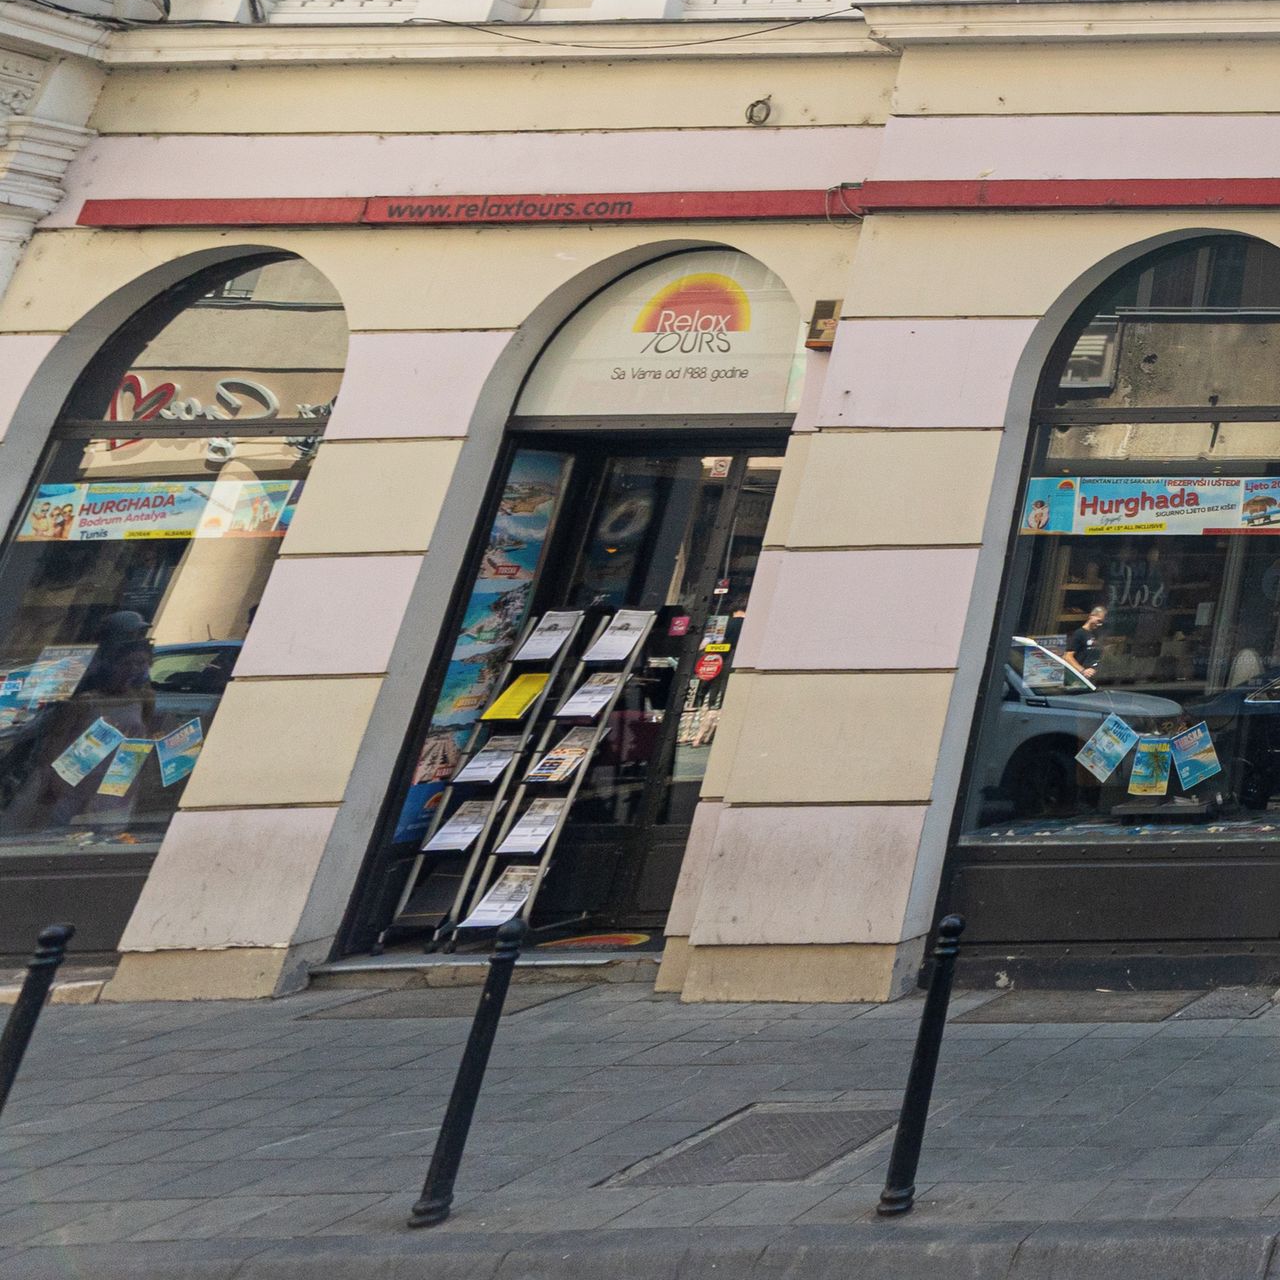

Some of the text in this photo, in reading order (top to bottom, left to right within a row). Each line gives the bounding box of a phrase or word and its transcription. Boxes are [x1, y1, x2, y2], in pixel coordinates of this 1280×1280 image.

[387, 197, 634, 219] www.relaxtours.com
[656, 310, 732, 333] Relax
[640, 332, 732, 354] TOURS
[610, 367, 626, 381] Sa
[665, 367, 682, 380] od
[711, 366, 750, 383] godine
[1245, 482, 1270, 493] Ljeto
[78, 494, 176, 517] HURGHADA
[1079, 487, 1200, 518] Hurghada
[1155, 509, 1185, 518] SIGURNO
[1186, 506, 1206, 515] LJETO
[1207, 504, 1220, 512] BEZ
[78, 510, 167, 528] Bodrum Antalya
[80, 529, 109, 540] Tunis
